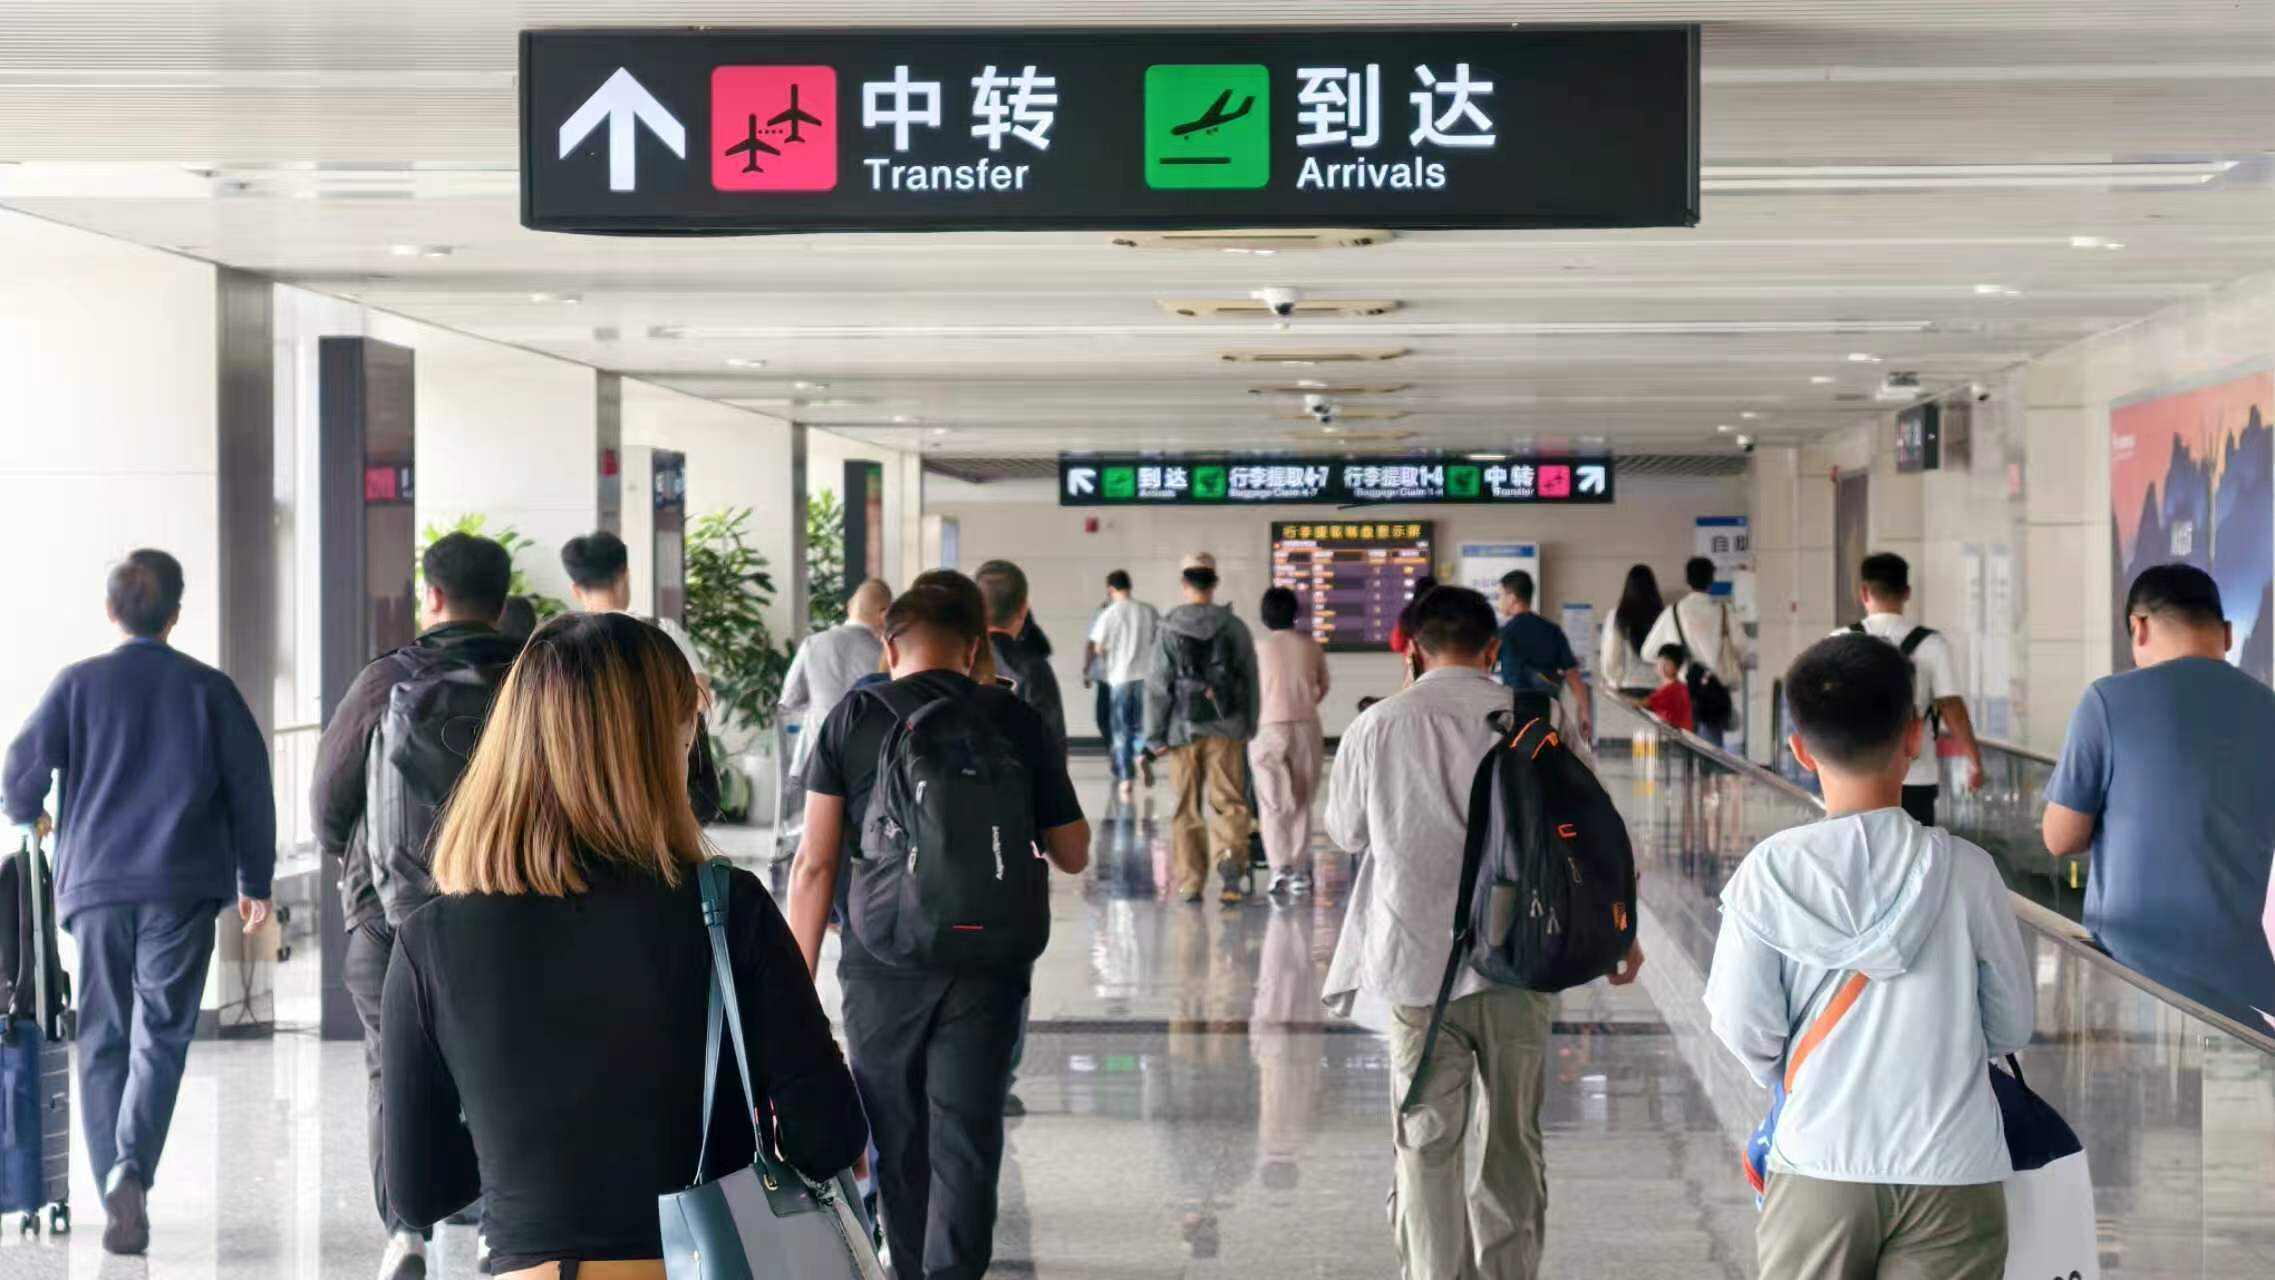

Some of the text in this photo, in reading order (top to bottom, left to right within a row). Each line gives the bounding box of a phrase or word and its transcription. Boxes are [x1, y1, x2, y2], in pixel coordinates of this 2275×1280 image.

[862, 65, 1058, 152] 中转
[1296, 62, 1497, 148] 到达
[863, 157, 1030, 191] Transfer
[1296, 156, 1446, 189] Arrivals
[1138, 466, 1188, 489] 到达
[1484, 465, 1535, 489] 中转
